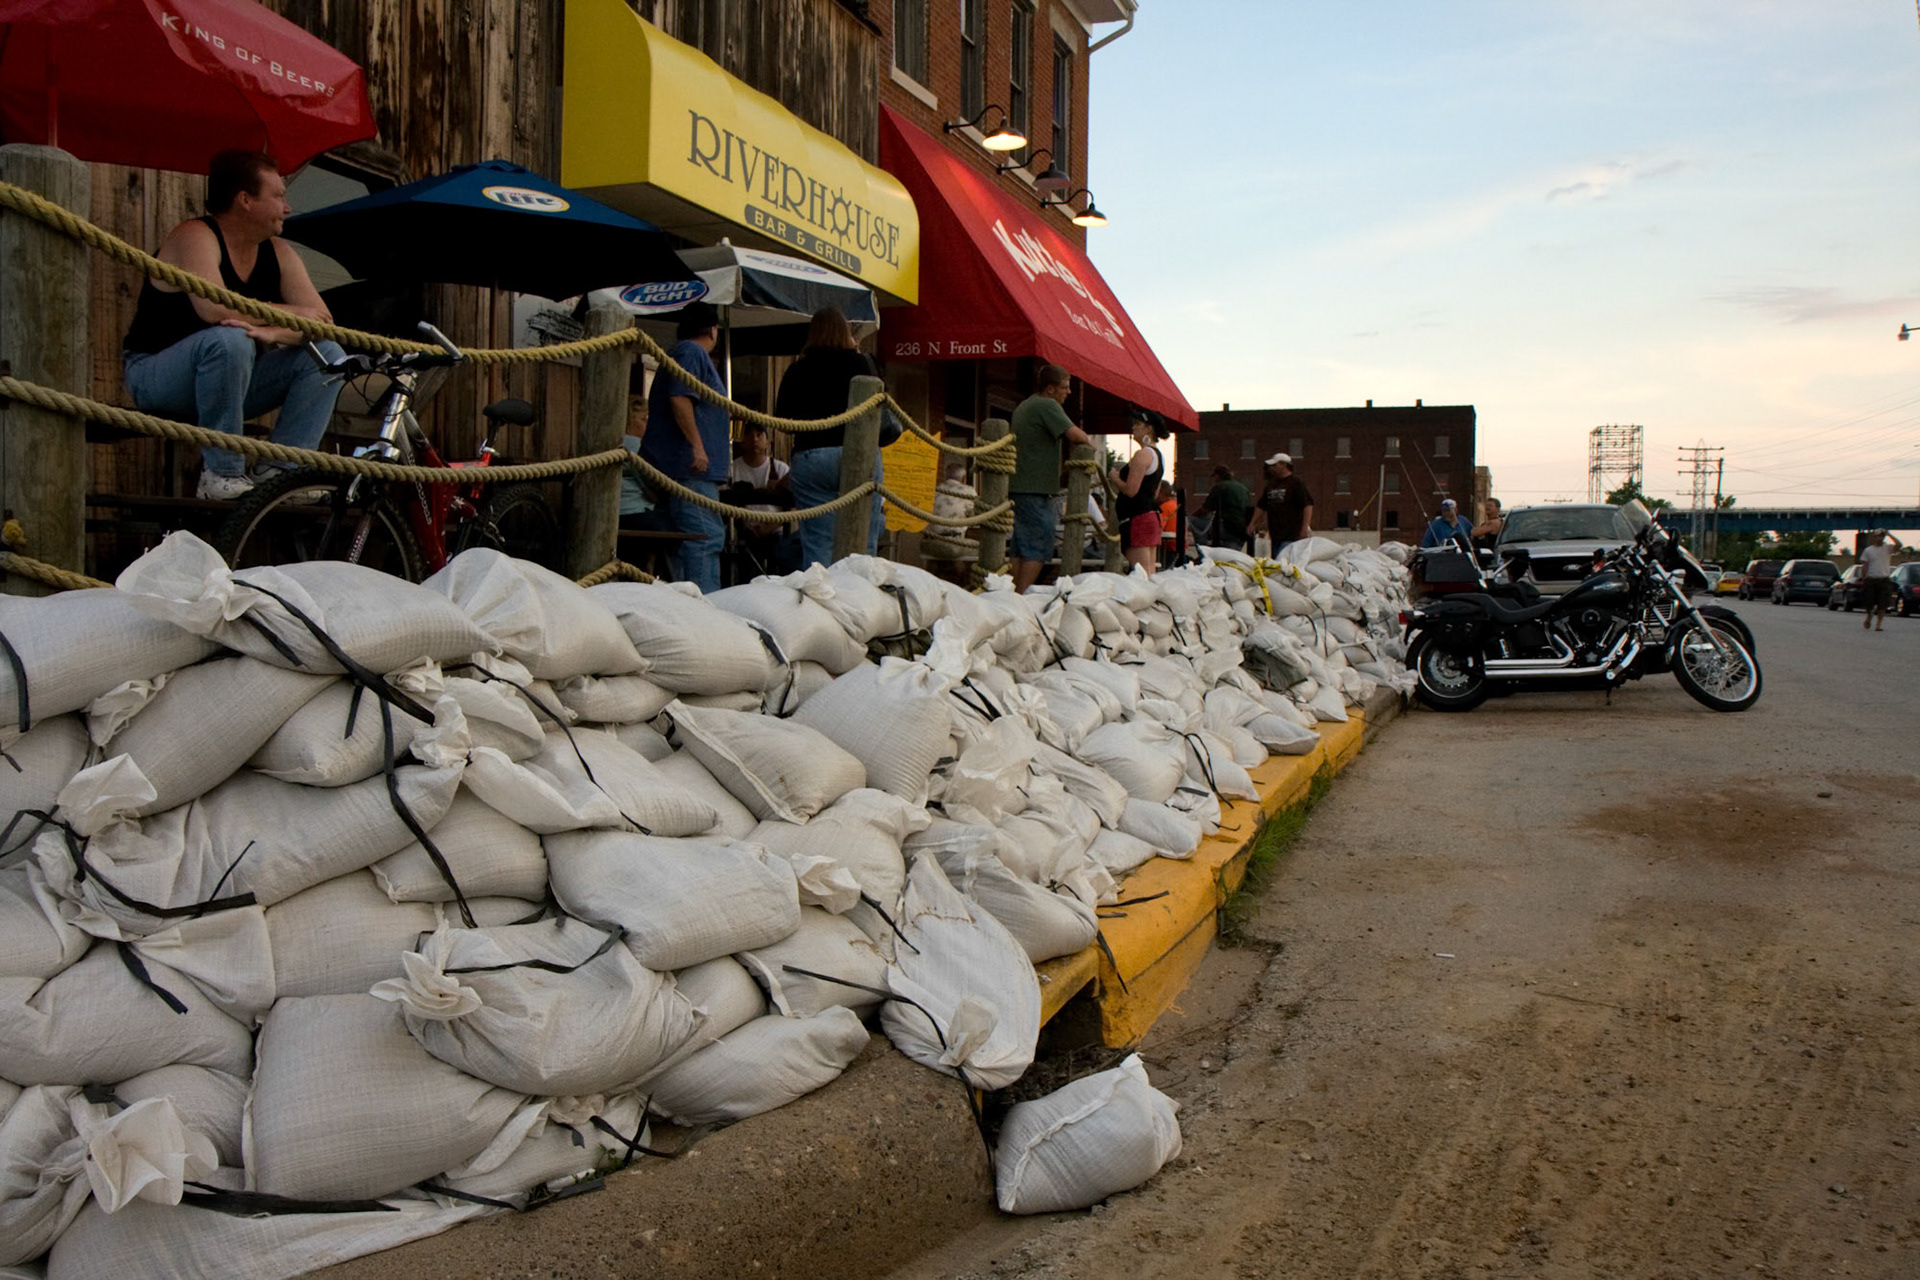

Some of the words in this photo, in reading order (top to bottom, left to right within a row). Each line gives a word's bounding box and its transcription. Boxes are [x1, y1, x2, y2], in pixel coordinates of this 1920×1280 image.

[162, 11, 226, 51] KING
[235, 46, 262, 65] OF
[270, 61, 335, 98] BEERS
[687, 109, 900, 271] RIVERHOUSE
[754, 210, 788, 238] BAR
[795, 230, 807, 247] &
[814, 240, 856, 270] GRILL
[633, 288, 698, 305] LIGHT
[642, 281, 689, 295] BUD
[895, 341, 921, 357] 236
[927, 341, 941, 355] N
[949, 339, 986, 355] Front
[992, 338, 1008, 354] St
